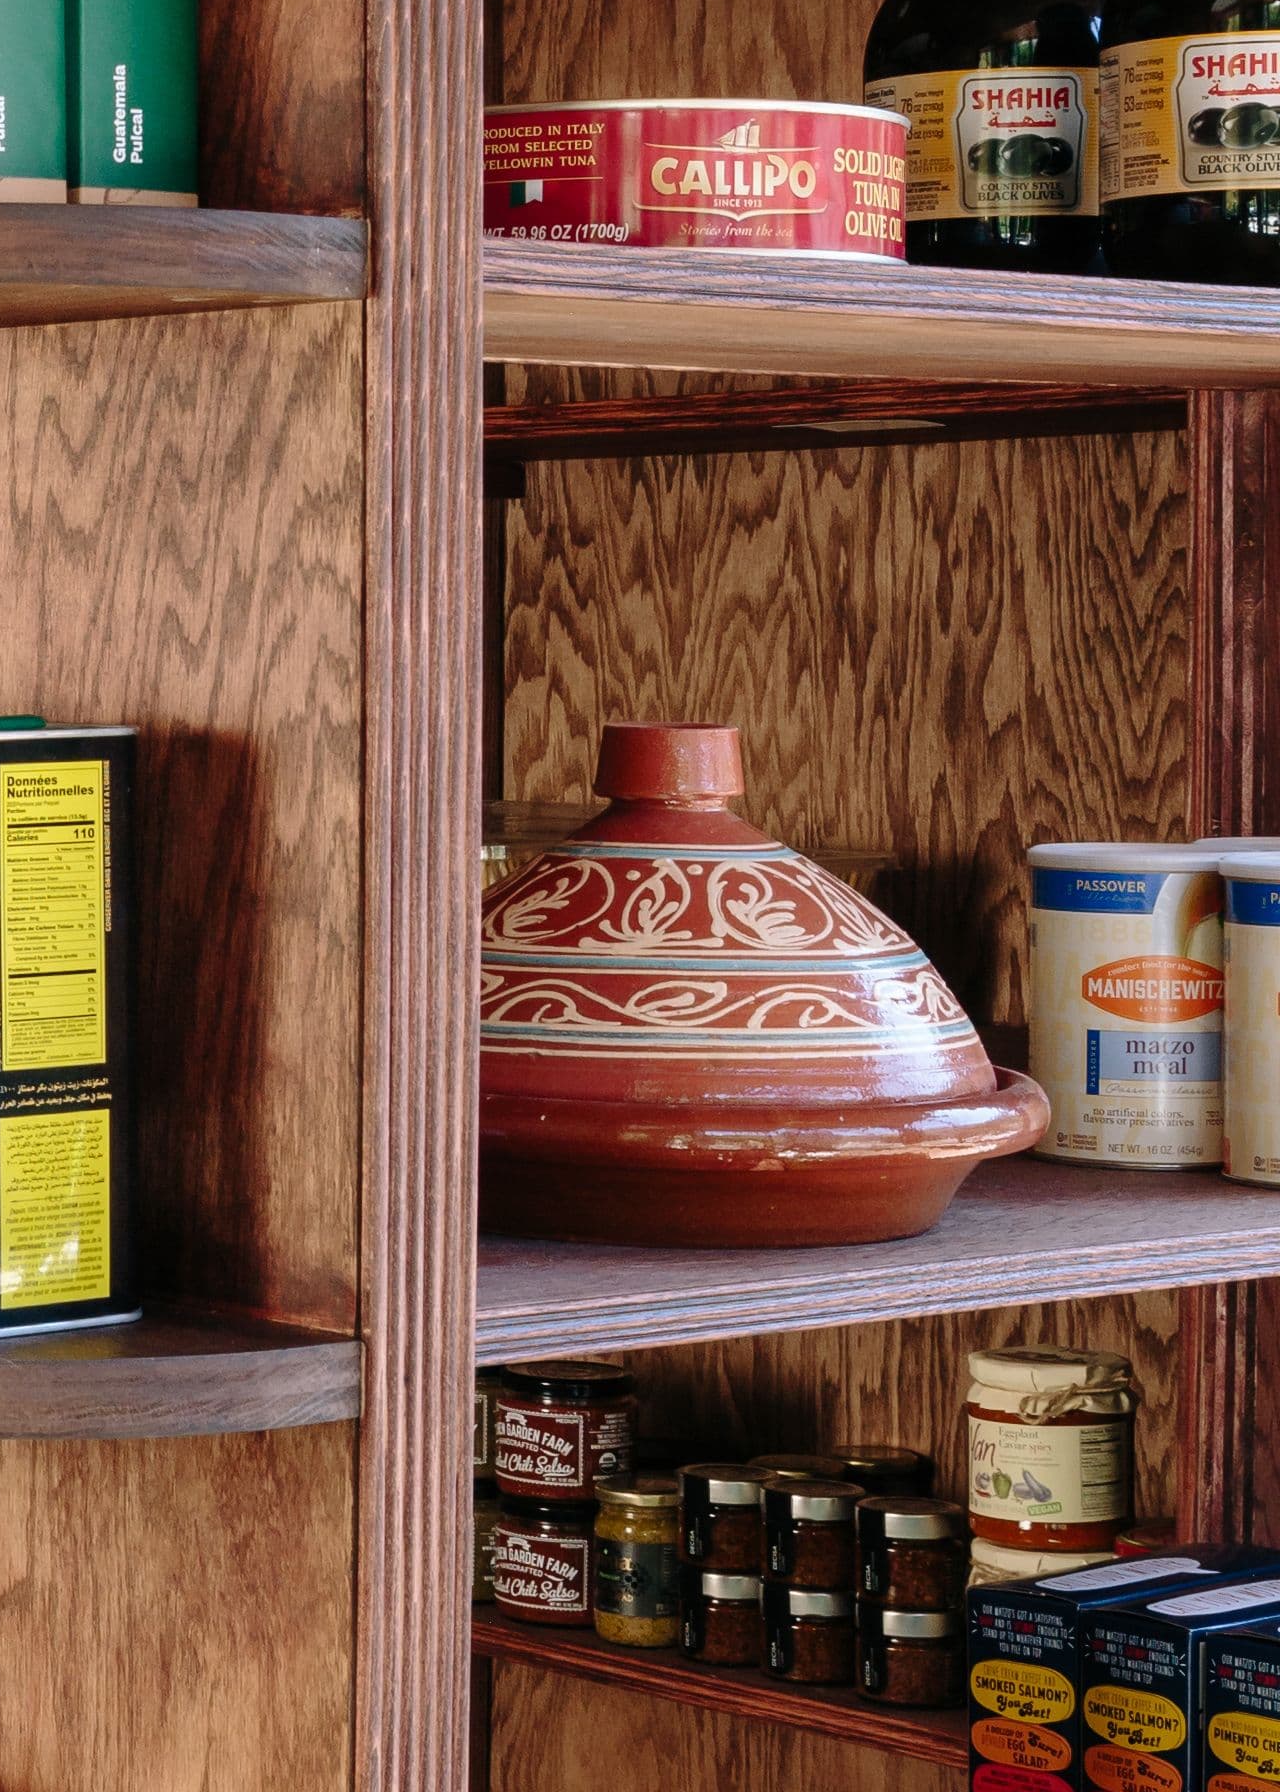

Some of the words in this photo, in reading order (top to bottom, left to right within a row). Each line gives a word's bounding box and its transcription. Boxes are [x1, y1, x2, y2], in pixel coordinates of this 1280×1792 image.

[1191, 51, 1280, 80] SHAHI
[1123, 67, 1135, 85] 76
[971, 85, 1070, 112] SHAHIA
[112, 63, 127, 164] Guatemala
[130, 107, 144, 165] Pulcal
[547, 125, 562, 137] IN
[566, 122, 605, 136] ITALY
[484, 141, 521, 154] FROM
[525, 139, 593, 153] SELECTED
[559, 154, 597, 168] TUNA
[833, 147, 882, 176] SOLID
[1200, 153, 1252, 166] COUNTRY
[650, 153, 817, 201] CALLIPO
[1197, 163, 1241, 176] BLACK
[852, 180, 889, 206] TUNA
[977, 190, 1019, 203] BLACK
[1021, 189, 1065, 202] OLIVES
[980, 182, 1030, 193] COUNTRY
[1032, 181, 1062, 191] STYLE
[713, 198, 741, 207] SINCE
[510, 225, 547, 241] 59.96
[550, 224, 572, 238] OZ
[575, 222, 630, 244] (1700g)
[678, 222, 721, 238] Stories
[724, 223, 753, 239] from
[844, 211, 888, 240] OLIVE
[6, 773, 59, 787] Données
[6, 784, 95, 799] Nutritionnelles
[73, 827, 95, 840] 110
[1075, 878, 1146, 894] PASSOVER
[1087, 976, 1224, 1001] MANISCHEWITZ
[1125, 1037, 1195, 1056] matzo
[1131, 1057, 1188, 1076] meal
[1082, 1116, 1114, 1127] flavors
[1128, 1116, 1195, 1129] preservatives
[1106, 1107, 1148, 1119] artificial
[1107, 1143, 1125, 1154] NET
[505, 1423, 540, 1444] GARDEN
[541, 1431, 574, 1457] FARM
[508, 1454, 534, 1473] Chili
[535, 1455, 575, 1478] Salsa
[1028, 1503, 1062, 1515] VEGAN
[508, 1547, 545, 1568] GARDEN
[546, 1558, 579, 1582] FARM
[510, 1579, 538, 1598] Chili
[539, 1581, 580, 1603] Salsa
[975, 1675, 1017, 1696] SMOKED
[1018, 1682, 1069, 1705] SALMON?
[996, 1694, 1021, 1712] You
[1019, 1701, 1051, 1720] Bet!
[1087, 1700, 1127, 1722] SMOKED
[1128, 1710, 1179, 1733] SALMON?
[1007, 1739, 1026, 1752] EGG
[1027, 1729, 1064, 1759] Sure!
[1213, 1726, 1260, 1750] PIMENTO
[1012, 1752, 1050, 1769] SALAD?
[1136, 1757, 1174, 1789] Sure!
